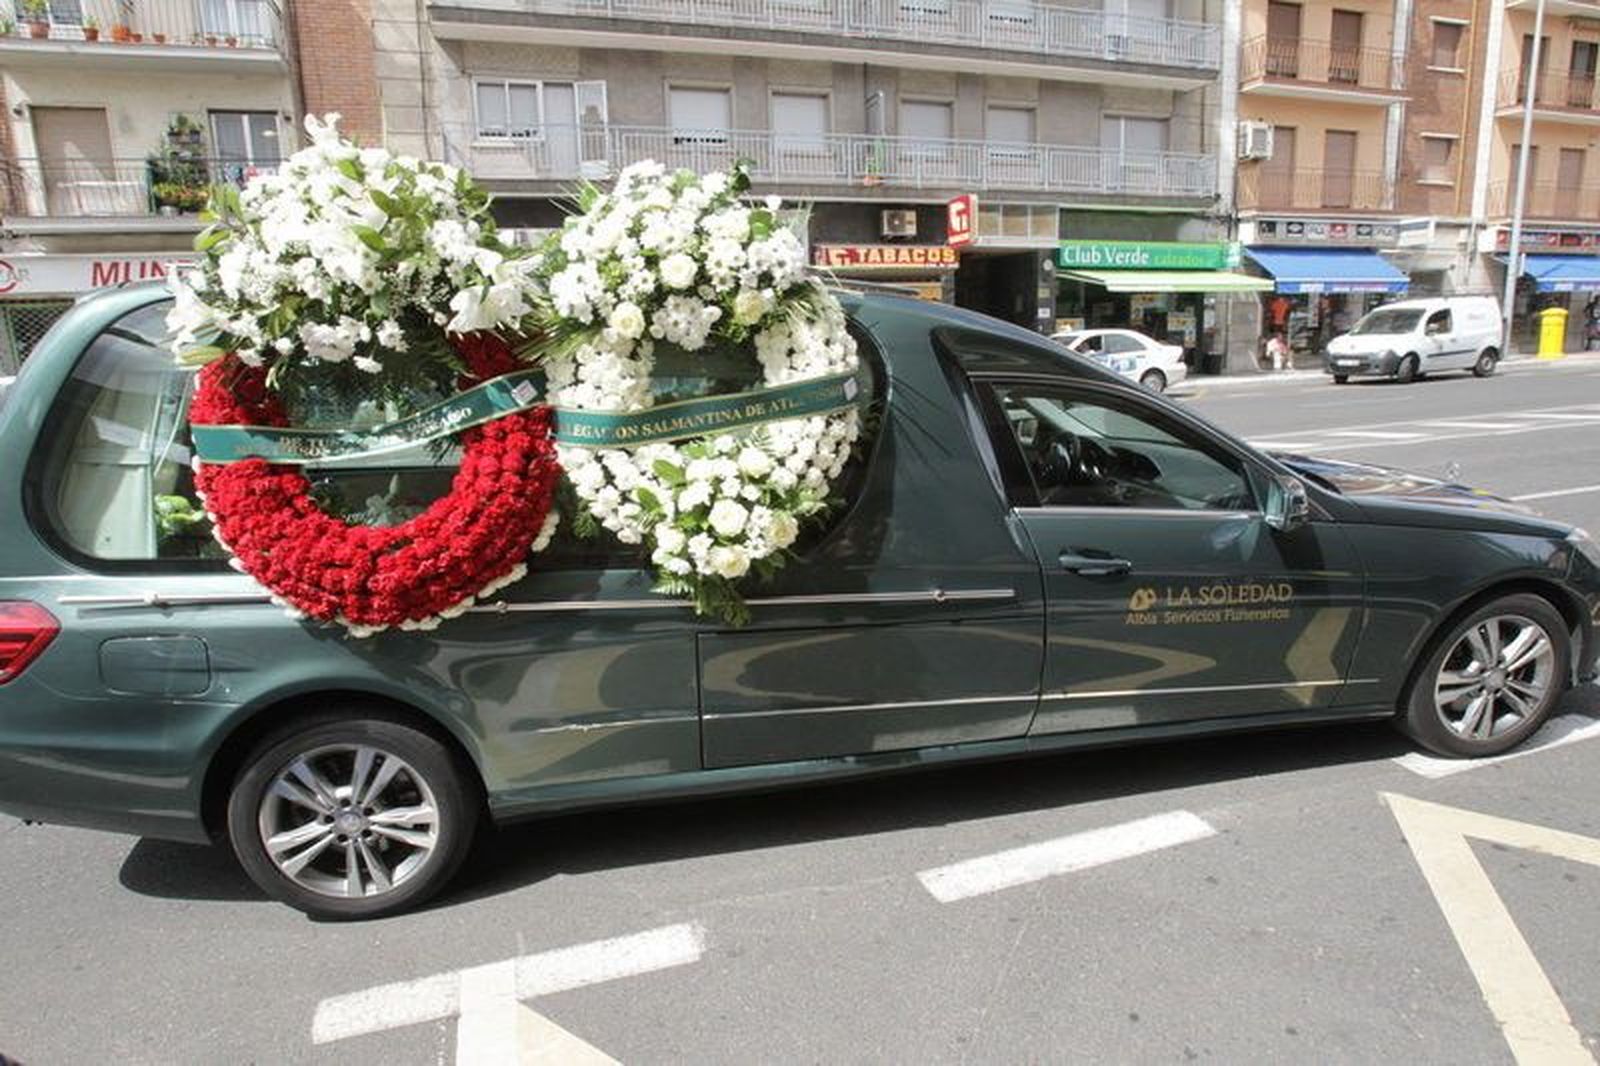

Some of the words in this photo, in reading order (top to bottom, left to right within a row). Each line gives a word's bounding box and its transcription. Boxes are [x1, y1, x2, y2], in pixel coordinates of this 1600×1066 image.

[855, 248, 956, 264] TABACOS
[1063, 245, 1101, 264] Club
[1104, 245, 1149, 264] Verde
[641, 409, 741, 437] SALMANTINA
[745, 404, 765, 417] DE
[1166, 587, 1193, 607] LA
[1199, 583, 1293, 606] SOLEDAD
[1164, 609, 1222, 625] Servicios
